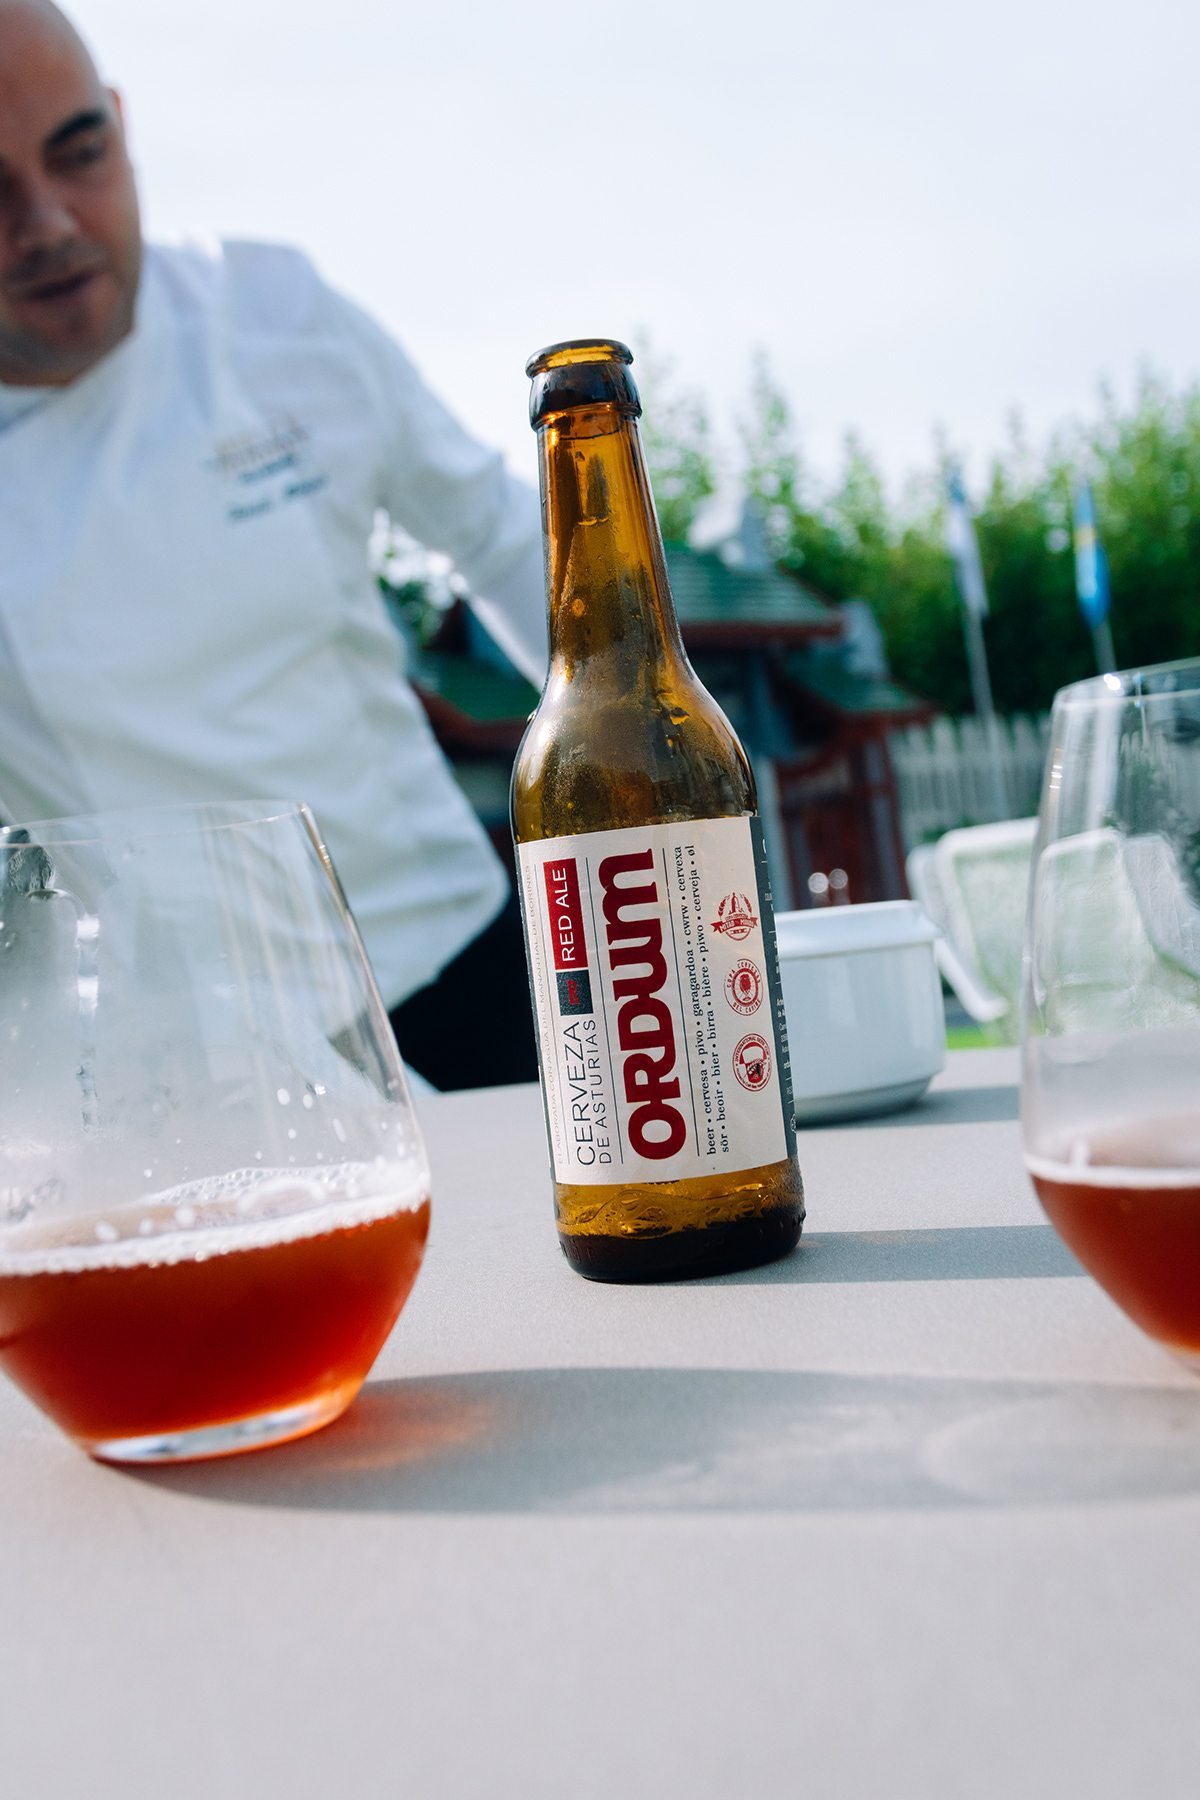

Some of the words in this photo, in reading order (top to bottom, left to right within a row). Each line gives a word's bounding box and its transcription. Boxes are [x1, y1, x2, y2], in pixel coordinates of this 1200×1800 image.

[684, 845, 696, 856] øl
[674, 846, 686, 891] cervexa
[552, 867, 570, 909] ALE
[688, 869, 702, 911] cerveja
[681, 905, 692, 936] cwrw
[558, 915, 576, 962] RED
[696, 924, 709, 953] piwo
[685, 949, 704, 1017] garagardoa
[701, 966, 712, 997] bière
[706, 1010, 717, 1040] birra
[695, 1030, 708, 1055] pivo
[583, 1019, 608, 1128] ASTURIAS
[710, 1052, 721, 1077] bier
[563, 1021, 596, 1166] CERVEZA
[700, 1069, 712, 1114] cervesa
[714, 1089, 726, 1122] beoir
[596, 1136, 612, 1164] DE
[706, 1127, 717, 1155] beer
[720, 1134, 729, 1152] sör
